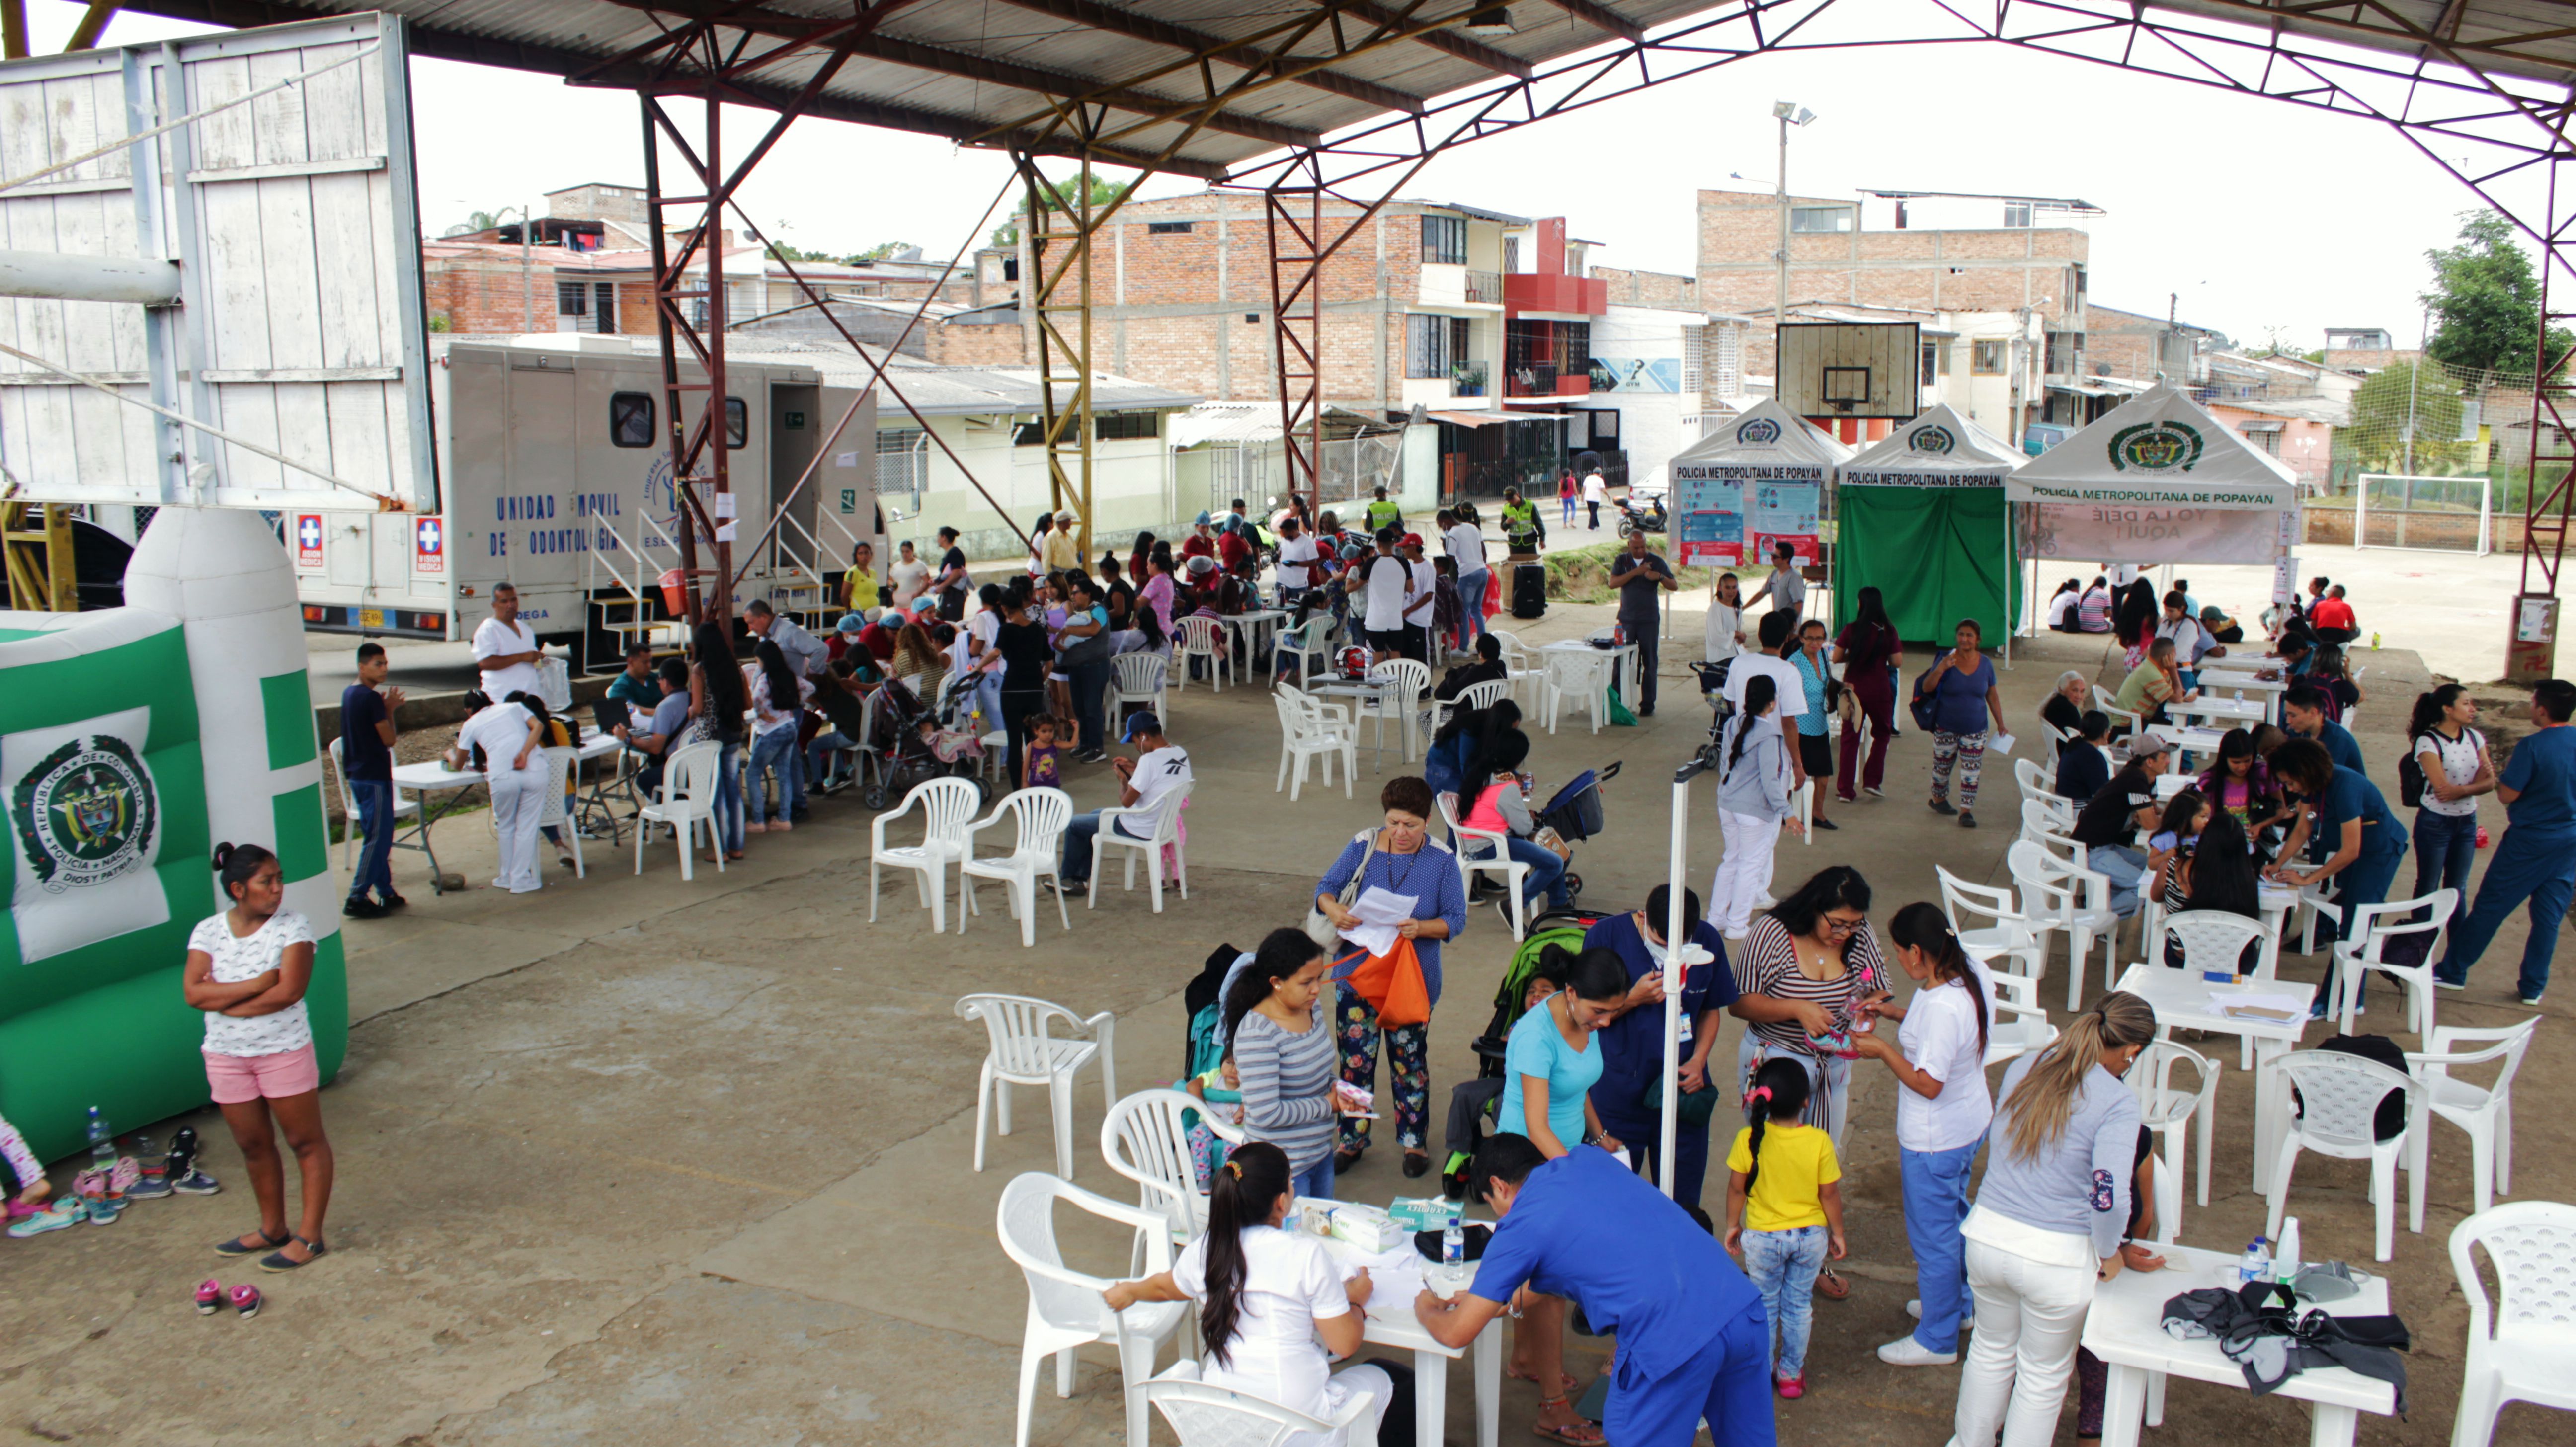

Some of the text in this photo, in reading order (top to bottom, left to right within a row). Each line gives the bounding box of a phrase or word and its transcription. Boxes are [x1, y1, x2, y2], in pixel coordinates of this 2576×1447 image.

[1677, 465, 1822, 479] POLICÍA METROPOLITANA DE POPAYÁN
[1847, 470, 2000, 487] POLICÍA METROPOLITANA DE POPAYÁN
[497, 493, 620, 521] UNIDAD MOVIL
[2032, 486, 2274, 505] POLICÍA METROPOLITANA DE POPAYÁN
[490, 527, 618, 556] DE ODONTOLGIA
[82, 753, 97, 763] DE
[107, 755, 143, 807] COLOMBIA
[102, 822, 143, 867] NACIONAL
[63, 873, 88, 884] DIOS
[101, 856, 134, 880] PATRIA
